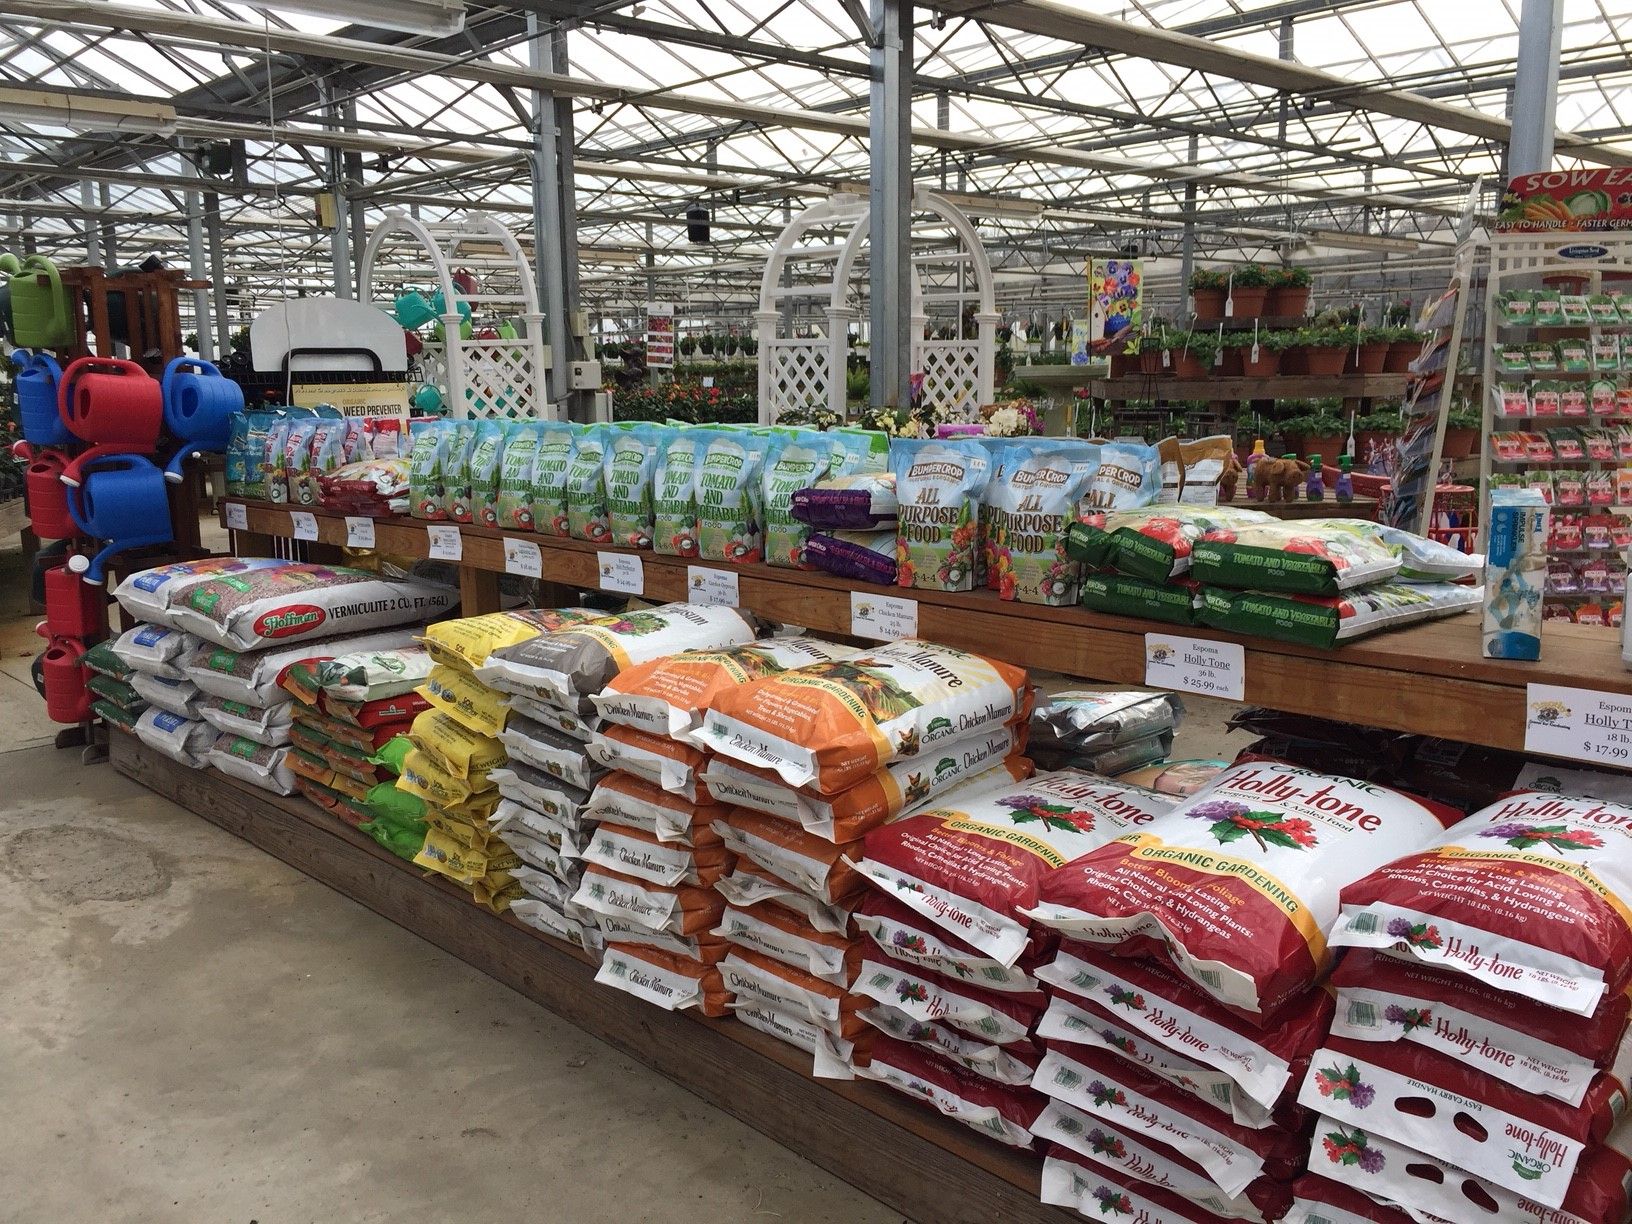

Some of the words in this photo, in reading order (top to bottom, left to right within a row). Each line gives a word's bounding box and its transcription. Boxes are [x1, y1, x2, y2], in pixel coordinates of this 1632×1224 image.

[1526, 170, 1600, 191] SOW
[1533, 220, 1566, 228] HANDLE
[343, 406, 365, 416] WEED
[367, 404, 402, 415] PREVENTER
[610, 470, 639, 485] TOMATO
[912, 464, 941, 476] BUMPER
[942, 463, 962, 478] CROP
[1046, 471, 1067, 483] CROP
[1117, 469, 1141, 485] CROP
[613, 486, 628, 498] AND
[701, 473, 737, 490] TOMATO
[704, 489, 722, 505] AND
[915, 488, 939, 504] ALL
[1017, 495, 1042, 512] ALL
[898, 507, 959, 524] PURPOSE
[1003, 514, 1063, 533] PURPOSE
[907, 524, 940, 543] FOOD
[1010, 533, 1043, 554] FOOD
[1233, 553, 1263, 566] TOMATO
[1263, 558, 1280, 569] AND
[1281, 558, 1328, 574] VEGETABLE
[264, 611, 317, 636] Hoffman
[328, 600, 388, 620] VERMICULITE
[397, 598, 412, 609] CU.
[414, 597, 426, 608] FT.
[1242, 601, 1271, 616] TOMATO
[1272, 608, 1289, 620] AND
[1290, 609, 1335, 628] VEGETABLE
[1275, 620, 1293, 628] FOOD
[885, 629, 900, 637] 14.99
[1193, 644, 1218, 654] Espoma
[912, 651, 963, 688] Manure
[1184, 654, 1206, 666] Holly
[1209, 658, 1230, 669] Tone
[1191, 679, 1214, 690] 25.99
[782, 676, 824, 689] ORGANIC
[823, 682, 866, 718] GARDENING
[922, 725, 958, 744] ORGANIC
[959, 713, 986, 732] Chicken
[985, 703, 1012, 721] Manure
[1585, 713, 1619, 729] Holly
[730, 734, 754, 754] Chicken
[755, 743, 782, 765] Manure
[1584, 740, 1591, 751] $
[1595, 744, 1628, 758] 17.99
[1620, 734, 1632, 744] lb.
[931, 765, 964, 787] ORGANIC
[963, 751, 989, 769] Chicken
[987, 738, 1010, 758] Manure
[1270, 765, 1386, 798] ORGANIC
[1028, 776, 1155, 826] Holly-tone
[1214, 788, 1260, 801] Evergreen
[1291, 803, 1325, 819] Azalea
[1327, 817, 1353, 833] Food
[1215, 769, 1382, 832] Holly-tone
[950, 821, 1007, 840] ORGANIC
[619, 848, 641, 867] Chicken
[640, 853, 666, 874] Manure
[901, 832, 928, 845] Original
[928, 843, 952, 856] Choice
[979, 863, 1003, 876] Loving
[1003, 871, 1028, 888] Plants:
[937, 836, 963, 851] Natural
[967, 848, 986, 861] Long
[986, 856, 1012, 871] Lasting
[901, 841, 927, 856] Rhodos,
[968, 865, 1011, 888] Hydrangeas
[1119, 858, 1154, 872] Better
[1449, 851, 1519, 860] ORGANIC
[1522, 855, 1608, 896] GARDENING
[1115, 867, 1131, 876] All
[1132, 871, 1167, 893] Natural
[1194, 888, 1230, 912] Lasting
[1141, 848, 1213, 867] ORGANIC
[1216, 860, 1299, 913] GARDENING
[1435, 864, 1478, 874] Natural
[1488, 872, 1518, 885] Long
[1520, 880, 1564, 899] Lasting
[1084, 867, 1119, 882] Original
[1120, 877, 1152, 899] Choice
[1187, 895, 1220, 920] Loving
[1219, 914, 1254, 938] Plants:
[1087, 877, 1121, 895] Rhodos,
[1166, 899, 1174, 908] &
[1176, 903, 1232, 940] Hydrangeas
[1388, 874, 1429, 886] Rhodos,
[1432, 880, 1489, 899] Camellias,
[1503, 896, 1575, 924] Hydrangeas
[1426, 870, 1464, 881] Choice
[1466, 876, 1484, 884] for
[1484, 880, 1513, 892] Acid
[1514, 888, 1555, 907] Loving
[1557, 902, 1599, 926] Plants:
[1434, 892, 1465, 903] WEIGHT
[1477, 902, 1492, 911] LBS.
[1495, 907, 1514, 917] (8.16
[1514, 914, 1527, 923] kg)
[1443, 937, 1524, 980] Holly-tone
[629, 969, 652, 988] Chicken
[650, 977, 674, 998] Manure
[1144, 1008, 1210, 1054] Holly-tone
[1434, 1017, 1516, 1068] Holly-tone
[1527, 1056, 1541, 1064] NET
[1541, 1061, 1568, 1076] WEIGHT
[1528, 1063, 1542, 1073] LBS.
[1407, 1079, 1438, 1095] HANDLE
[1438, 1089, 1462, 1104] CARRY
[1464, 1101, 1482, 1112] EASY
[1506, 1123, 1568, 1168] Holly-tone
[1507, 1149, 1551, 1174] ORGANIC
